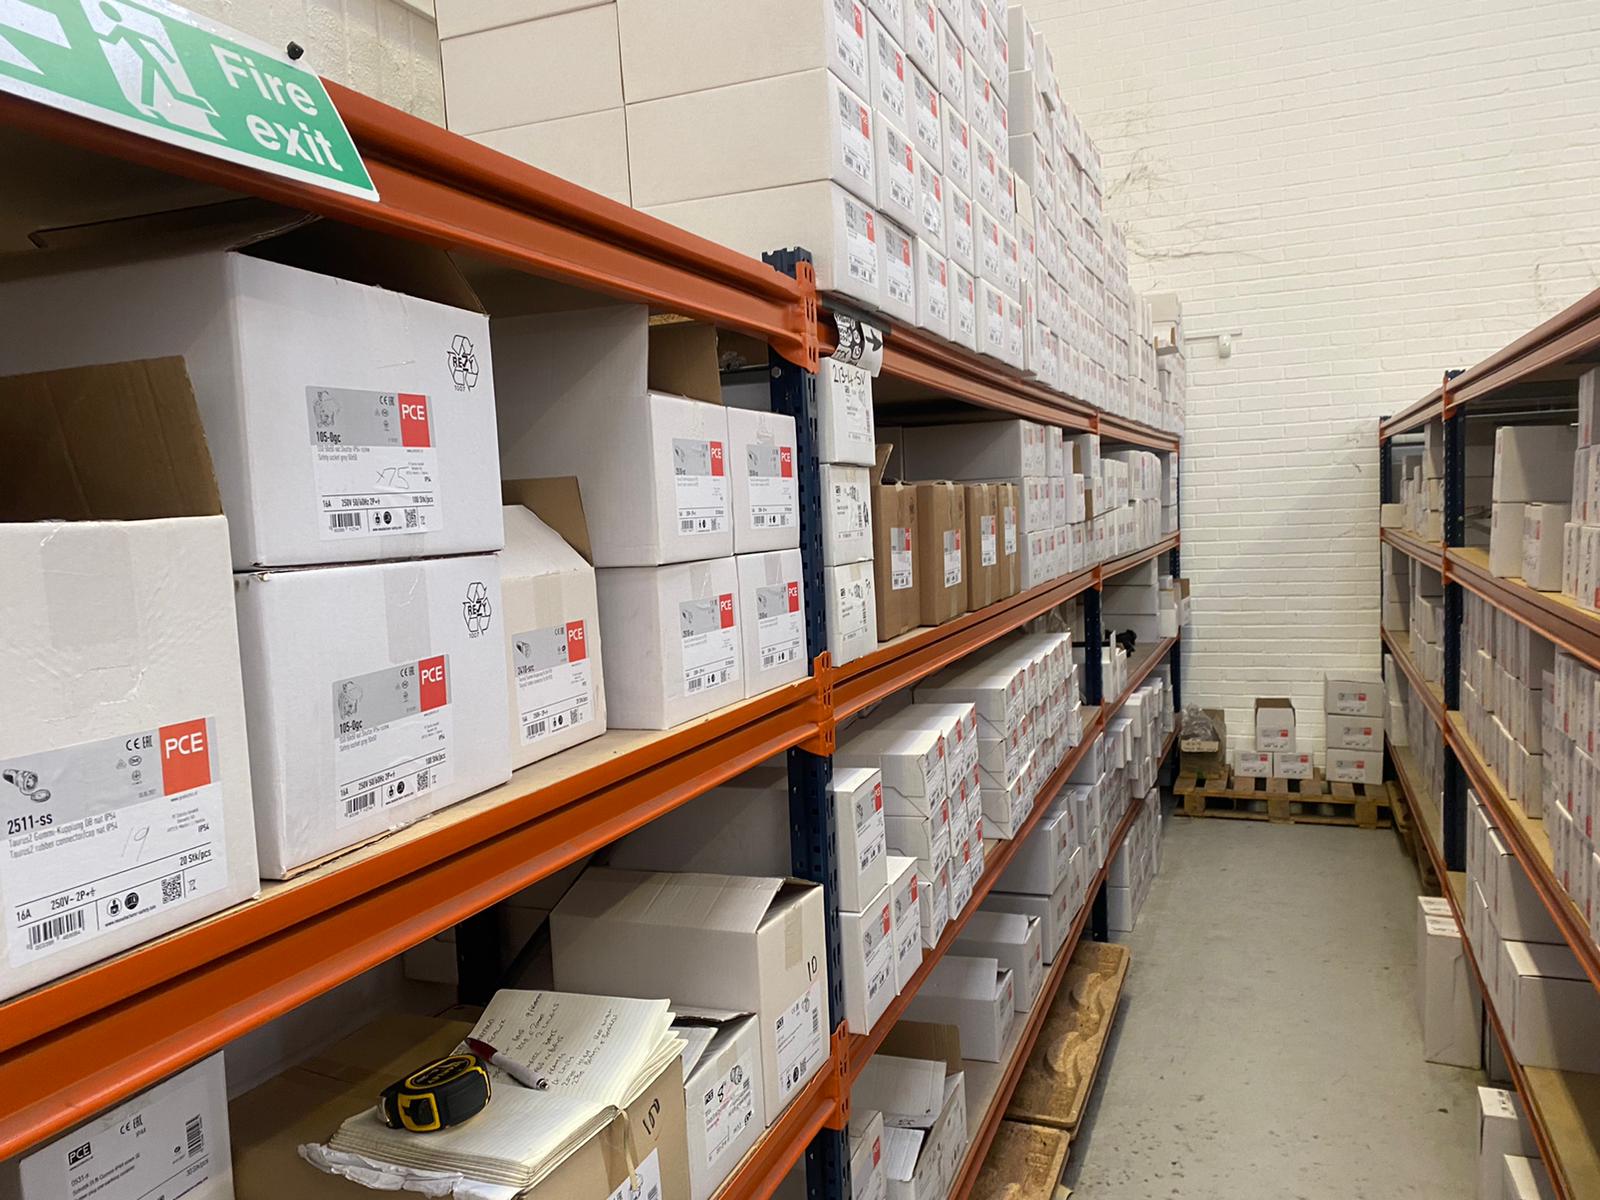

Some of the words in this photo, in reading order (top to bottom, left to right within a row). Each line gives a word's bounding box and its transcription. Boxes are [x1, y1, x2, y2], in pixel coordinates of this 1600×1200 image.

[211, 44, 318, 117] Fire
[246, 114, 343, 172] exit
[401, 404, 425, 420] PCE
[712, 447, 721, 459] PCE
[781, 452, 791, 463] PCE
[789, 587, 797, 596] PCE
[721, 600, 732, 611] PCE
[568, 628, 584, 642] PCE
[421, 665, 442, 685] PCE
[165, 732, 204, 759] PCE
[7, 813, 53, 835] 2511-ss
[17, 908, 32, 922] 16A
[179, 856, 188, 867] 20
[188, 848, 212, 865] Stk/pcs
[807, 956, 818, 982] 10
[69, 1142, 92, 1165] PCE
